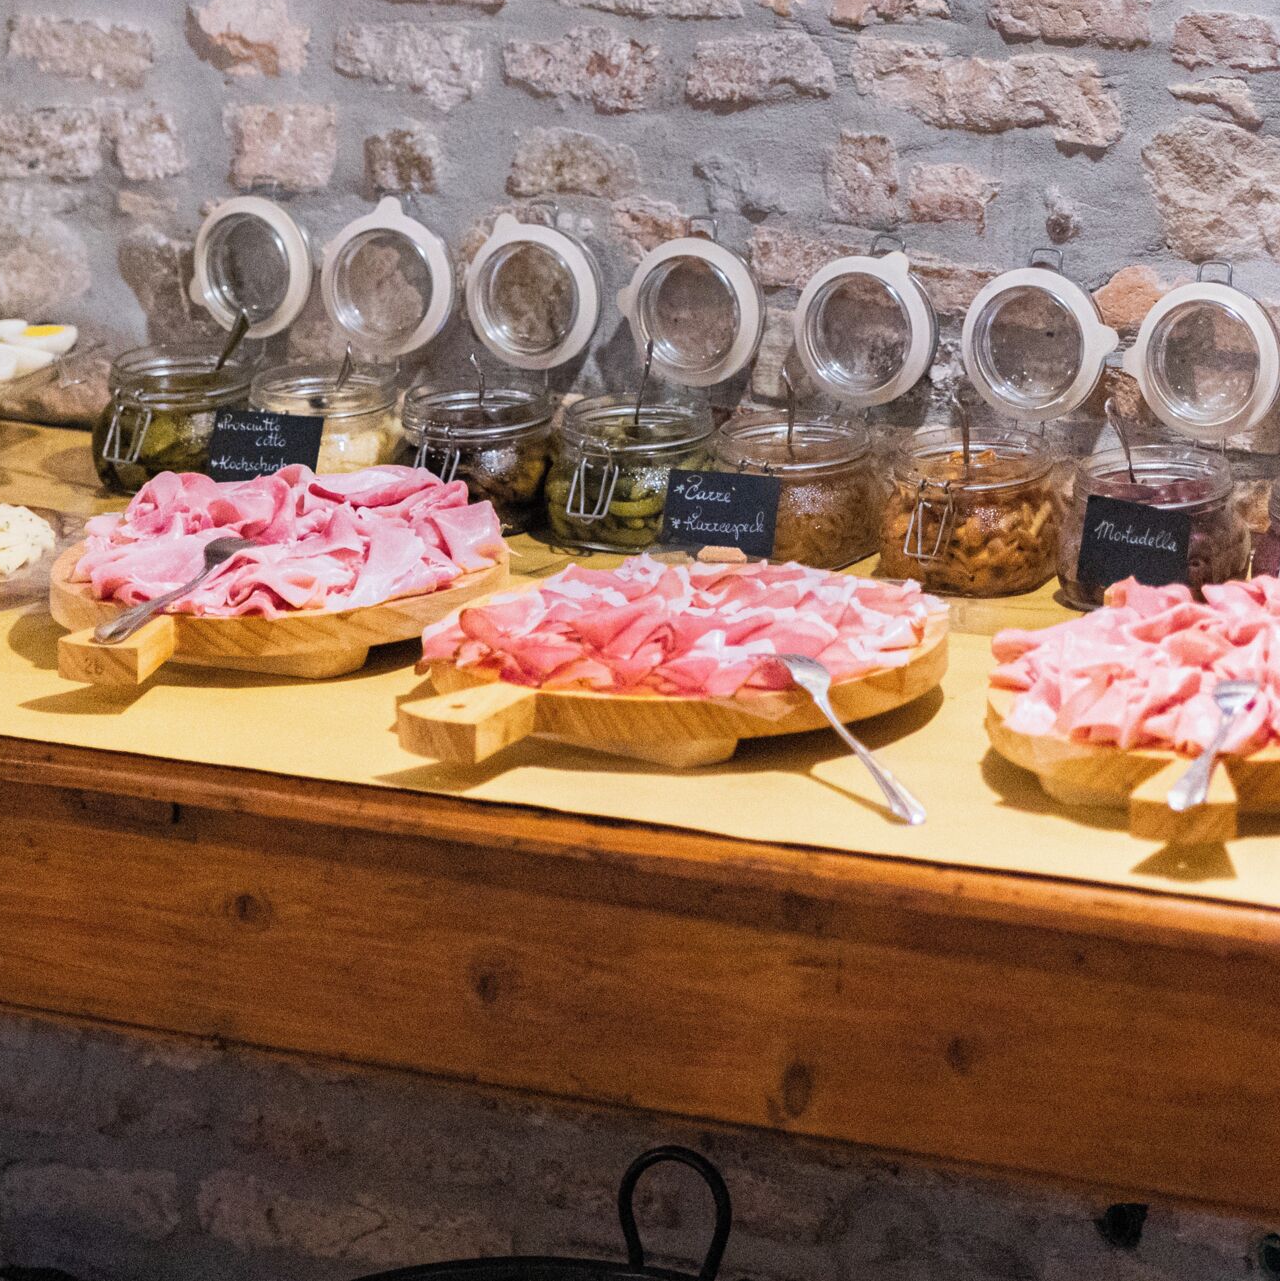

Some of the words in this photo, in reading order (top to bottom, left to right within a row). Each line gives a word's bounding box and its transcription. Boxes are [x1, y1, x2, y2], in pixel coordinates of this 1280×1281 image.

[222, 413, 281, 432] Prosciutto
[255, 433, 287, 448] cotto
[683, 505, 765, 541] Karreespeck
[1094, 520, 1178, 553] Mortadella
